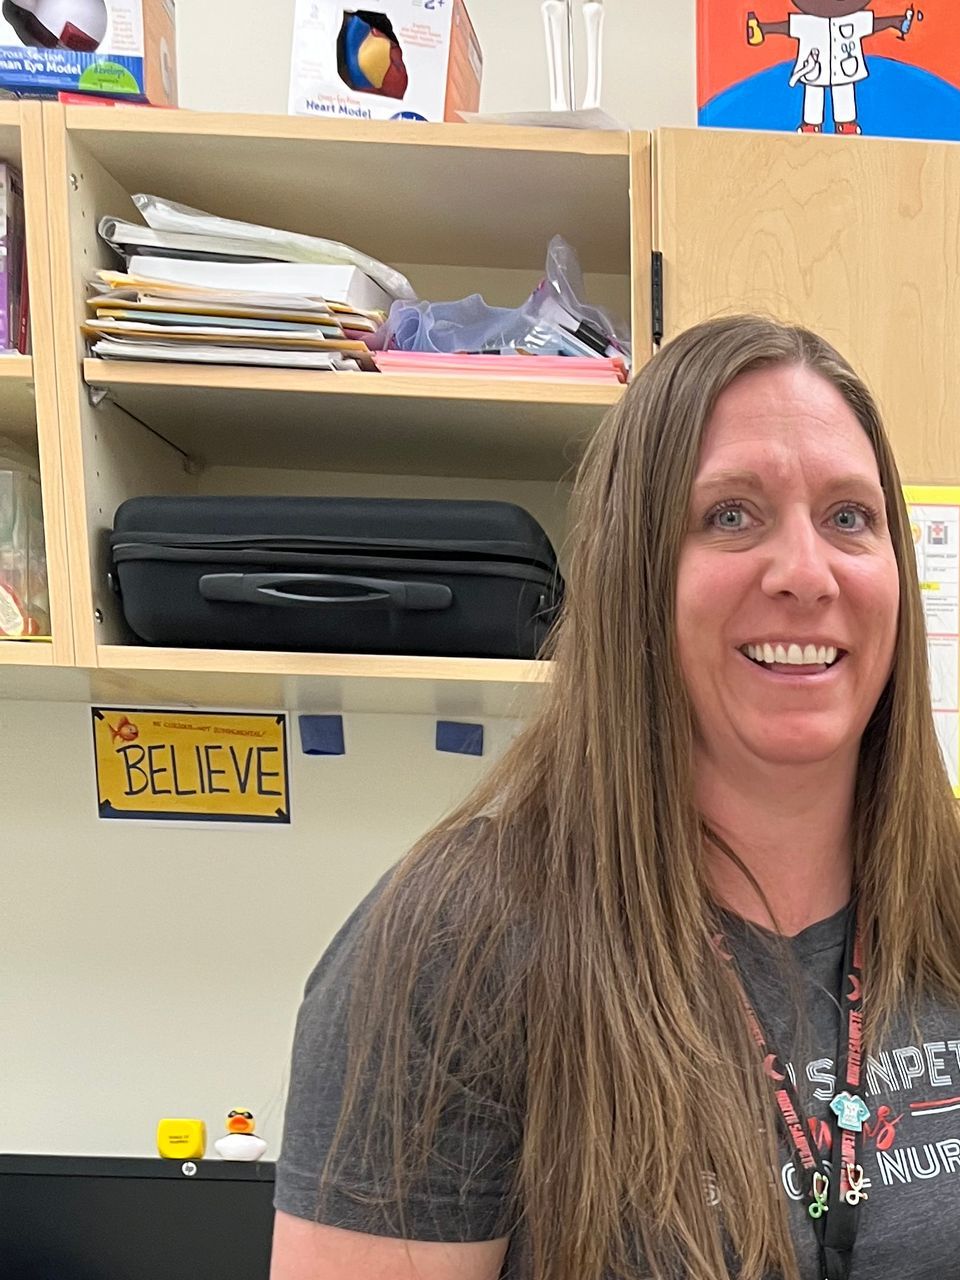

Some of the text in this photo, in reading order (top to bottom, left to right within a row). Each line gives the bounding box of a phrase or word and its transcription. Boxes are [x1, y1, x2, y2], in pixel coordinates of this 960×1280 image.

[47, 61, 82, 76] Model
[306, 99, 336, 114] Heart
[338, 104, 372, 120] Model
[116, 744, 283, 796] BELIEVE
